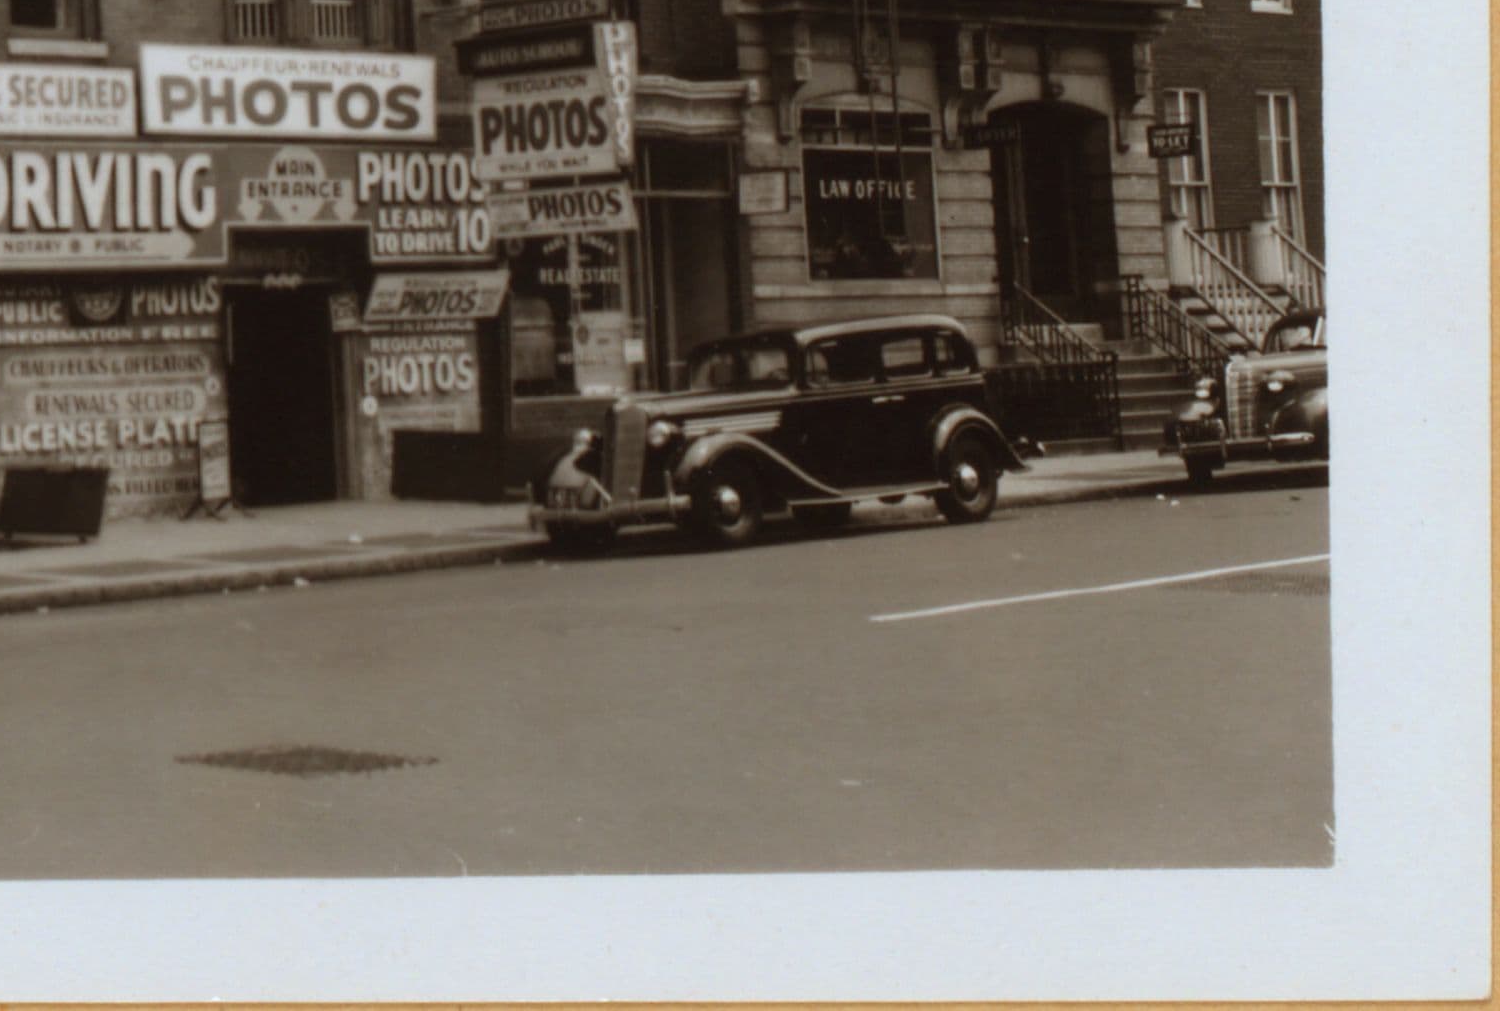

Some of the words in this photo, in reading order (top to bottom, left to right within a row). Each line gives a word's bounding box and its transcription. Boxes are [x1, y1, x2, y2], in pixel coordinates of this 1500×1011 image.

[9, 74, 128, 109] SECURED
[160, 76, 423, 131] PHOTOS
[37, 113, 122, 127] INSURANCE
[481, 95, 608, 156] PHOTOS
[274, 161, 318, 177] MAIN
[357, 152, 490, 204] PHOTOS
[246, 181, 344, 199] ENTRANCE
[818, 179, 850, 199] LAW
[855, 179, 916, 200] OFFICE
[528, 188, 623, 221] PHOTOS
[378, 207, 448, 230] LEARN
[2, 238, 64, 255] NOTARY
[94, 238, 147, 255] PUBLIC
[376, 231, 398, 253] TO
[399, 231, 455, 254] DRIVE
[538, 267, 570, 285] REAL
[576, 266, 622, 285] ESTATE
[399, 288, 478, 314] PHOTOS
[370, 336, 468, 352] REGULATION
[363, 352, 475, 397] PHOTOS
[32, 393, 119, 417] RENEWALS
[126, 390, 197, 414] SECURED
[0, 420, 108, 454] LICENSE
